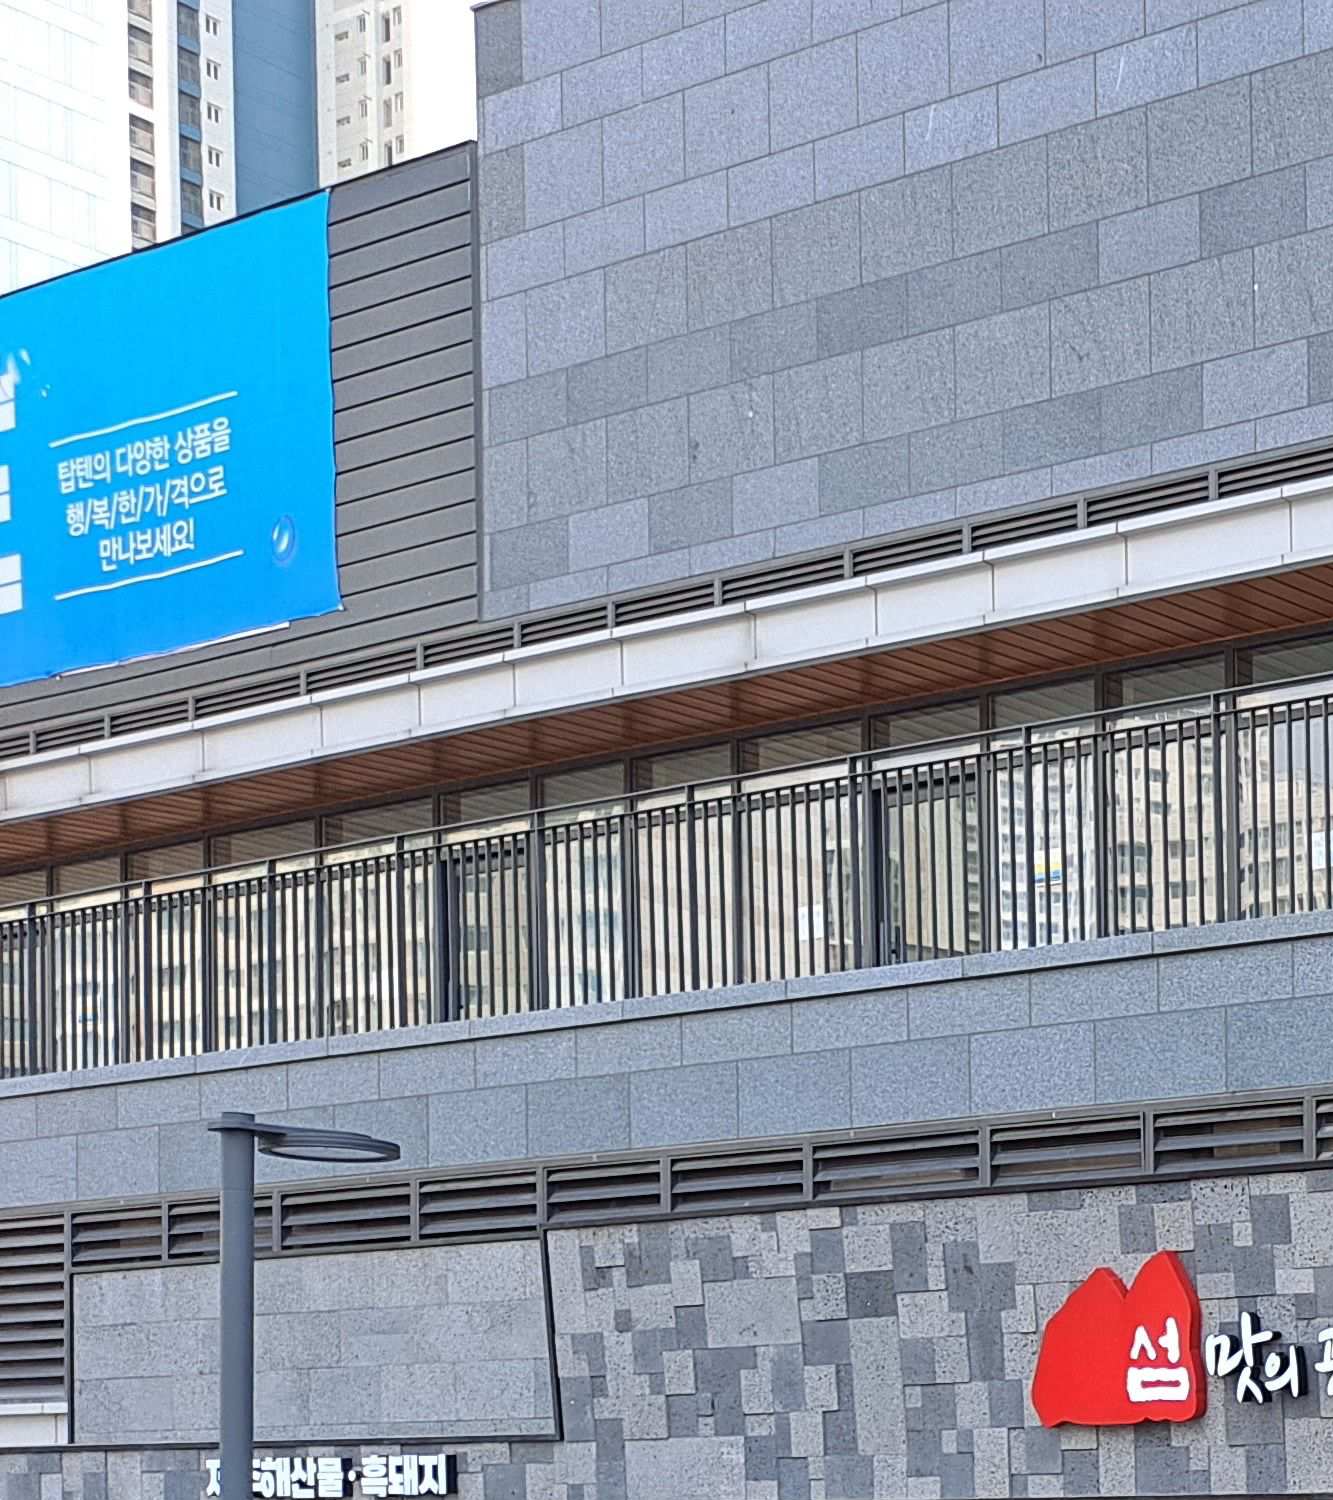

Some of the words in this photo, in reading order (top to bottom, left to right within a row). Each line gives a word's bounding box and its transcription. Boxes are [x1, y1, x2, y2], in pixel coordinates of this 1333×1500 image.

[58, 450, 111, 494] 탑텐의
[115, 435, 171, 475] 다양한
[174, 416, 232, 464] 상품을
[100, 518, 195, 571] 만나보세요!
[1126, 1316, 1191, 1403] 섬
[1205, 1311, 1302, 1405] 맛의
